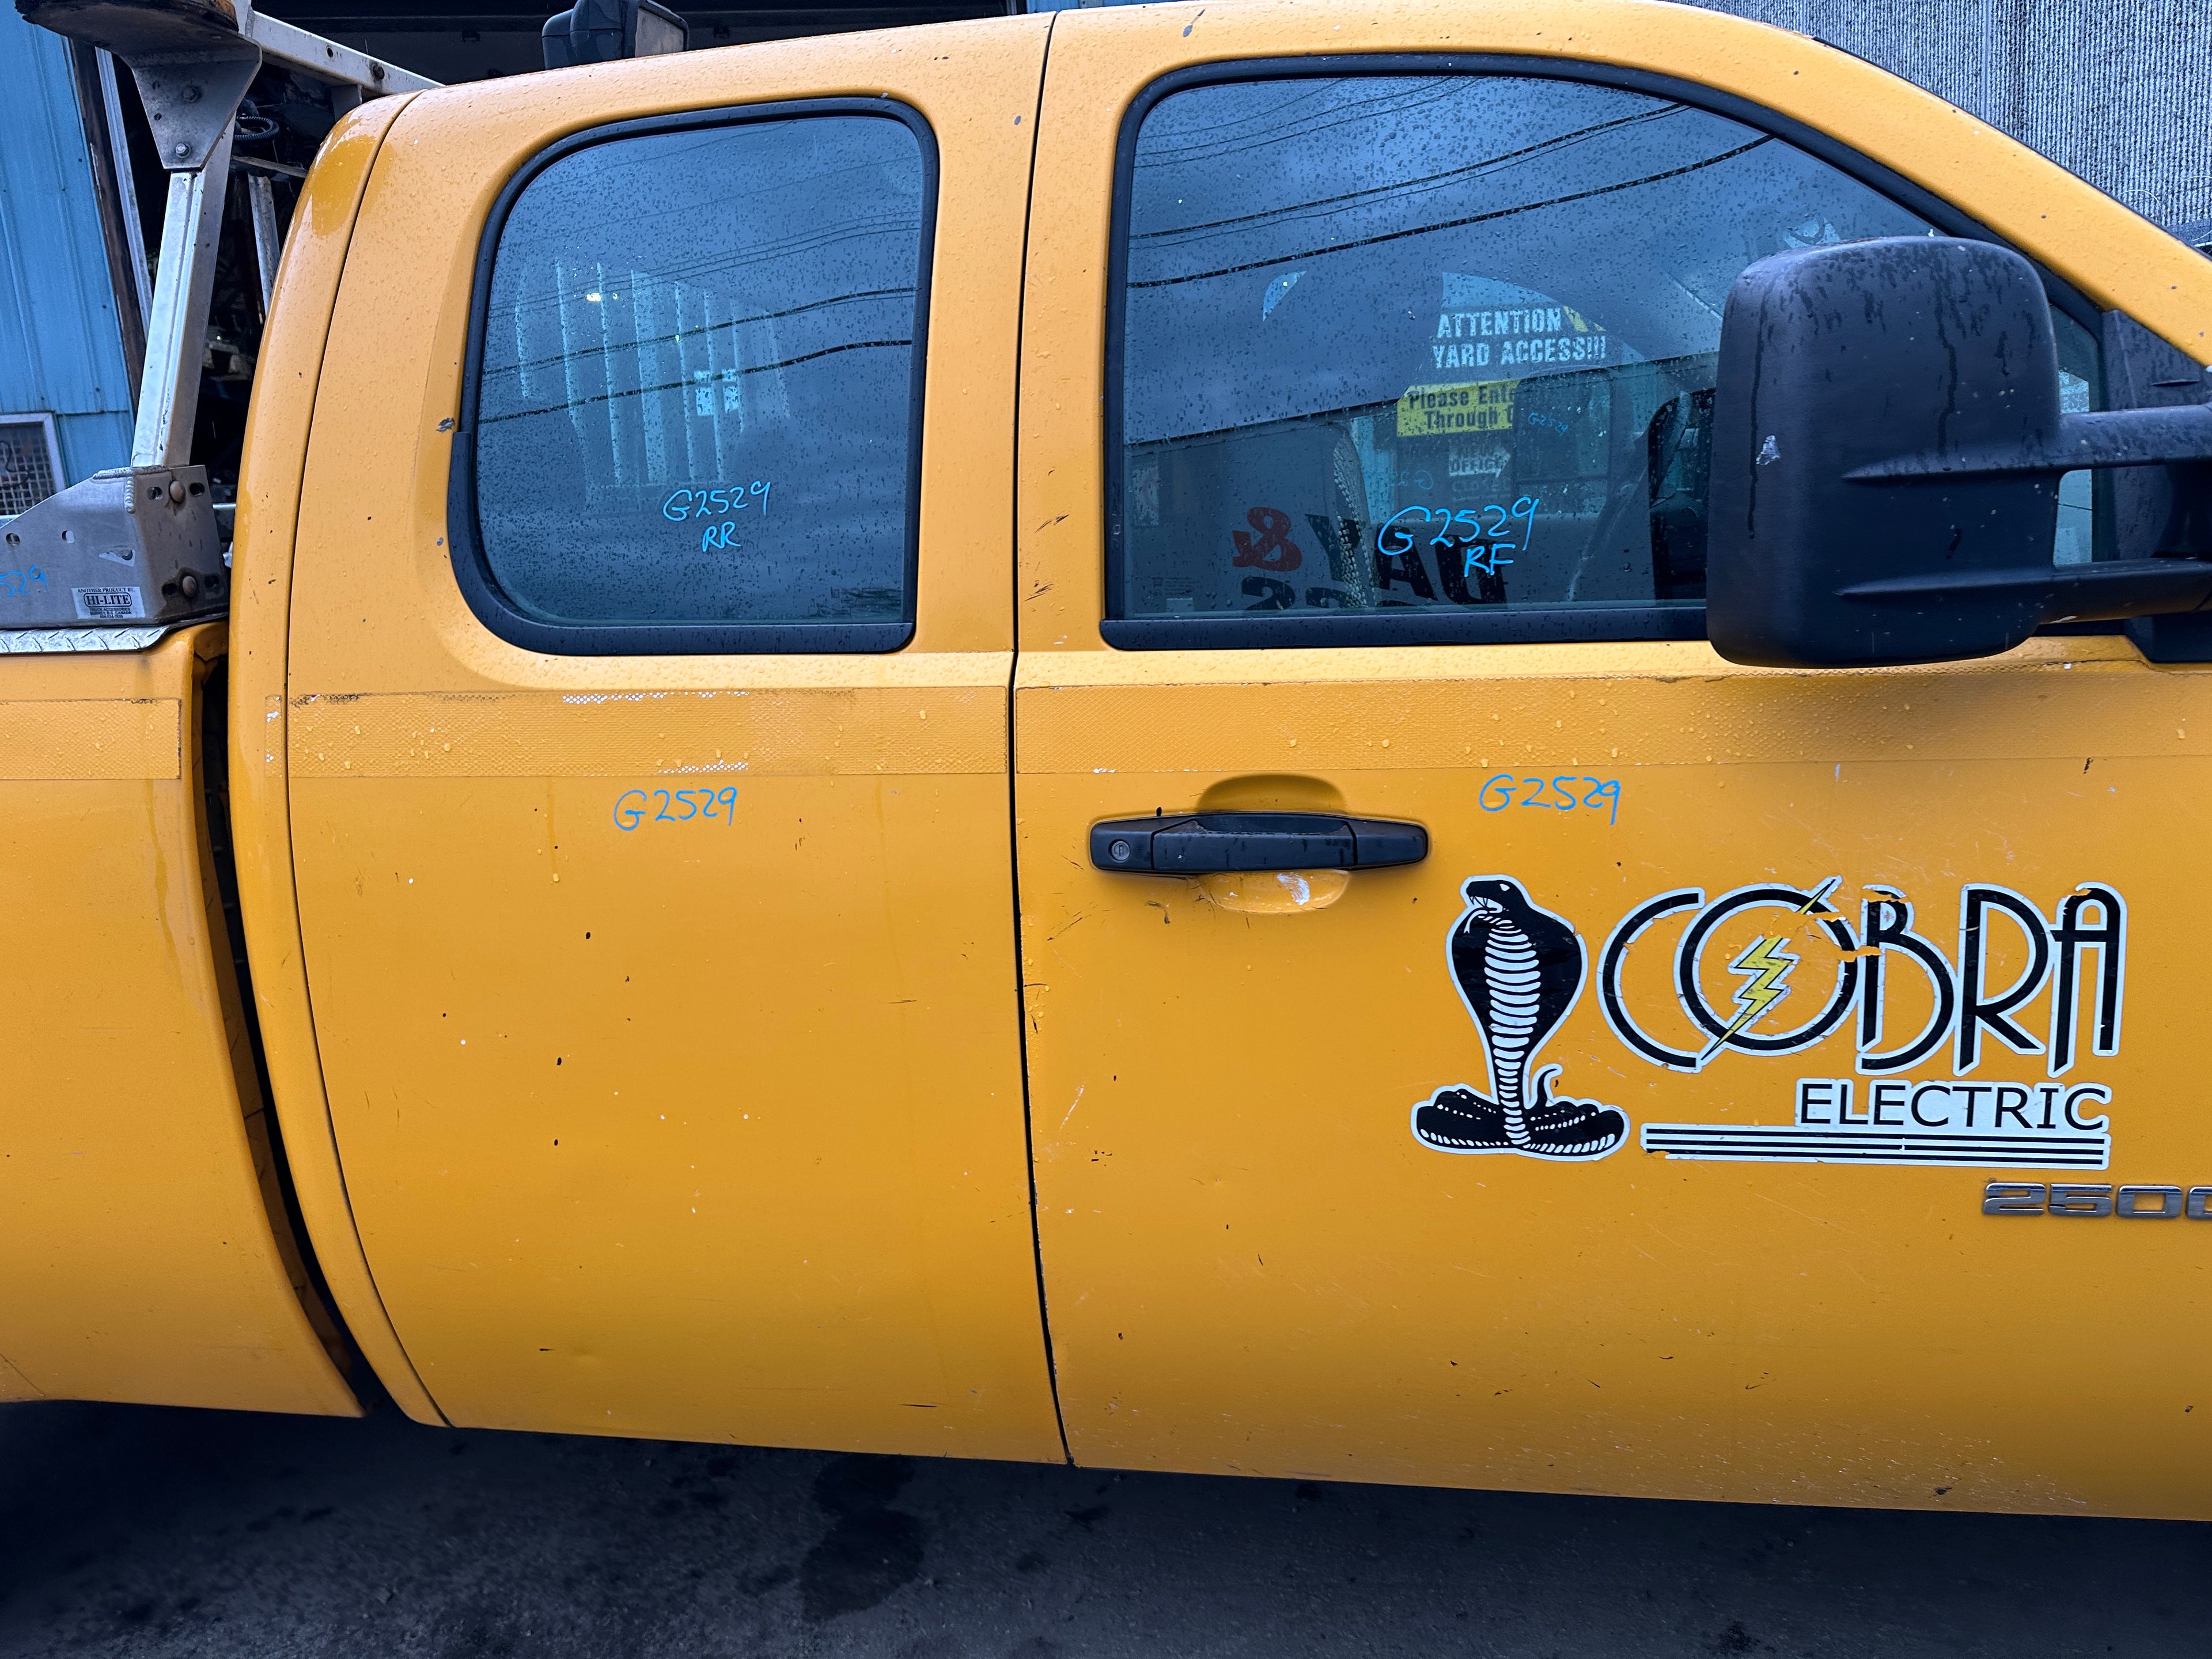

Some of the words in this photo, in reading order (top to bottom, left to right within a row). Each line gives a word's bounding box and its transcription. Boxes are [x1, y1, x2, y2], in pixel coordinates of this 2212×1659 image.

[1437, 308, 1561, 339] ATTENTION
[1431, 342, 1489, 369] YARD
[1501, 335, 1606, 366] ACCESS!!!
[1407, 387, 1469, 410] Please
[1424, 405, 1498, 429] Through
[662, 480, 771, 521] G2529
[702, 521, 742, 552] RR
[1377, 496, 1541, 555] G2529
[1463, 543, 1517, 578] RF
[86, 595, 130, 605] HI-LITE
[613, 786, 737, 831] G2529
[1479, 773, 1621, 826] G2529
[1600, 880, 2122, 1073] COBRA
[1800, 1083, 2106, 1131] ELECTRIC
